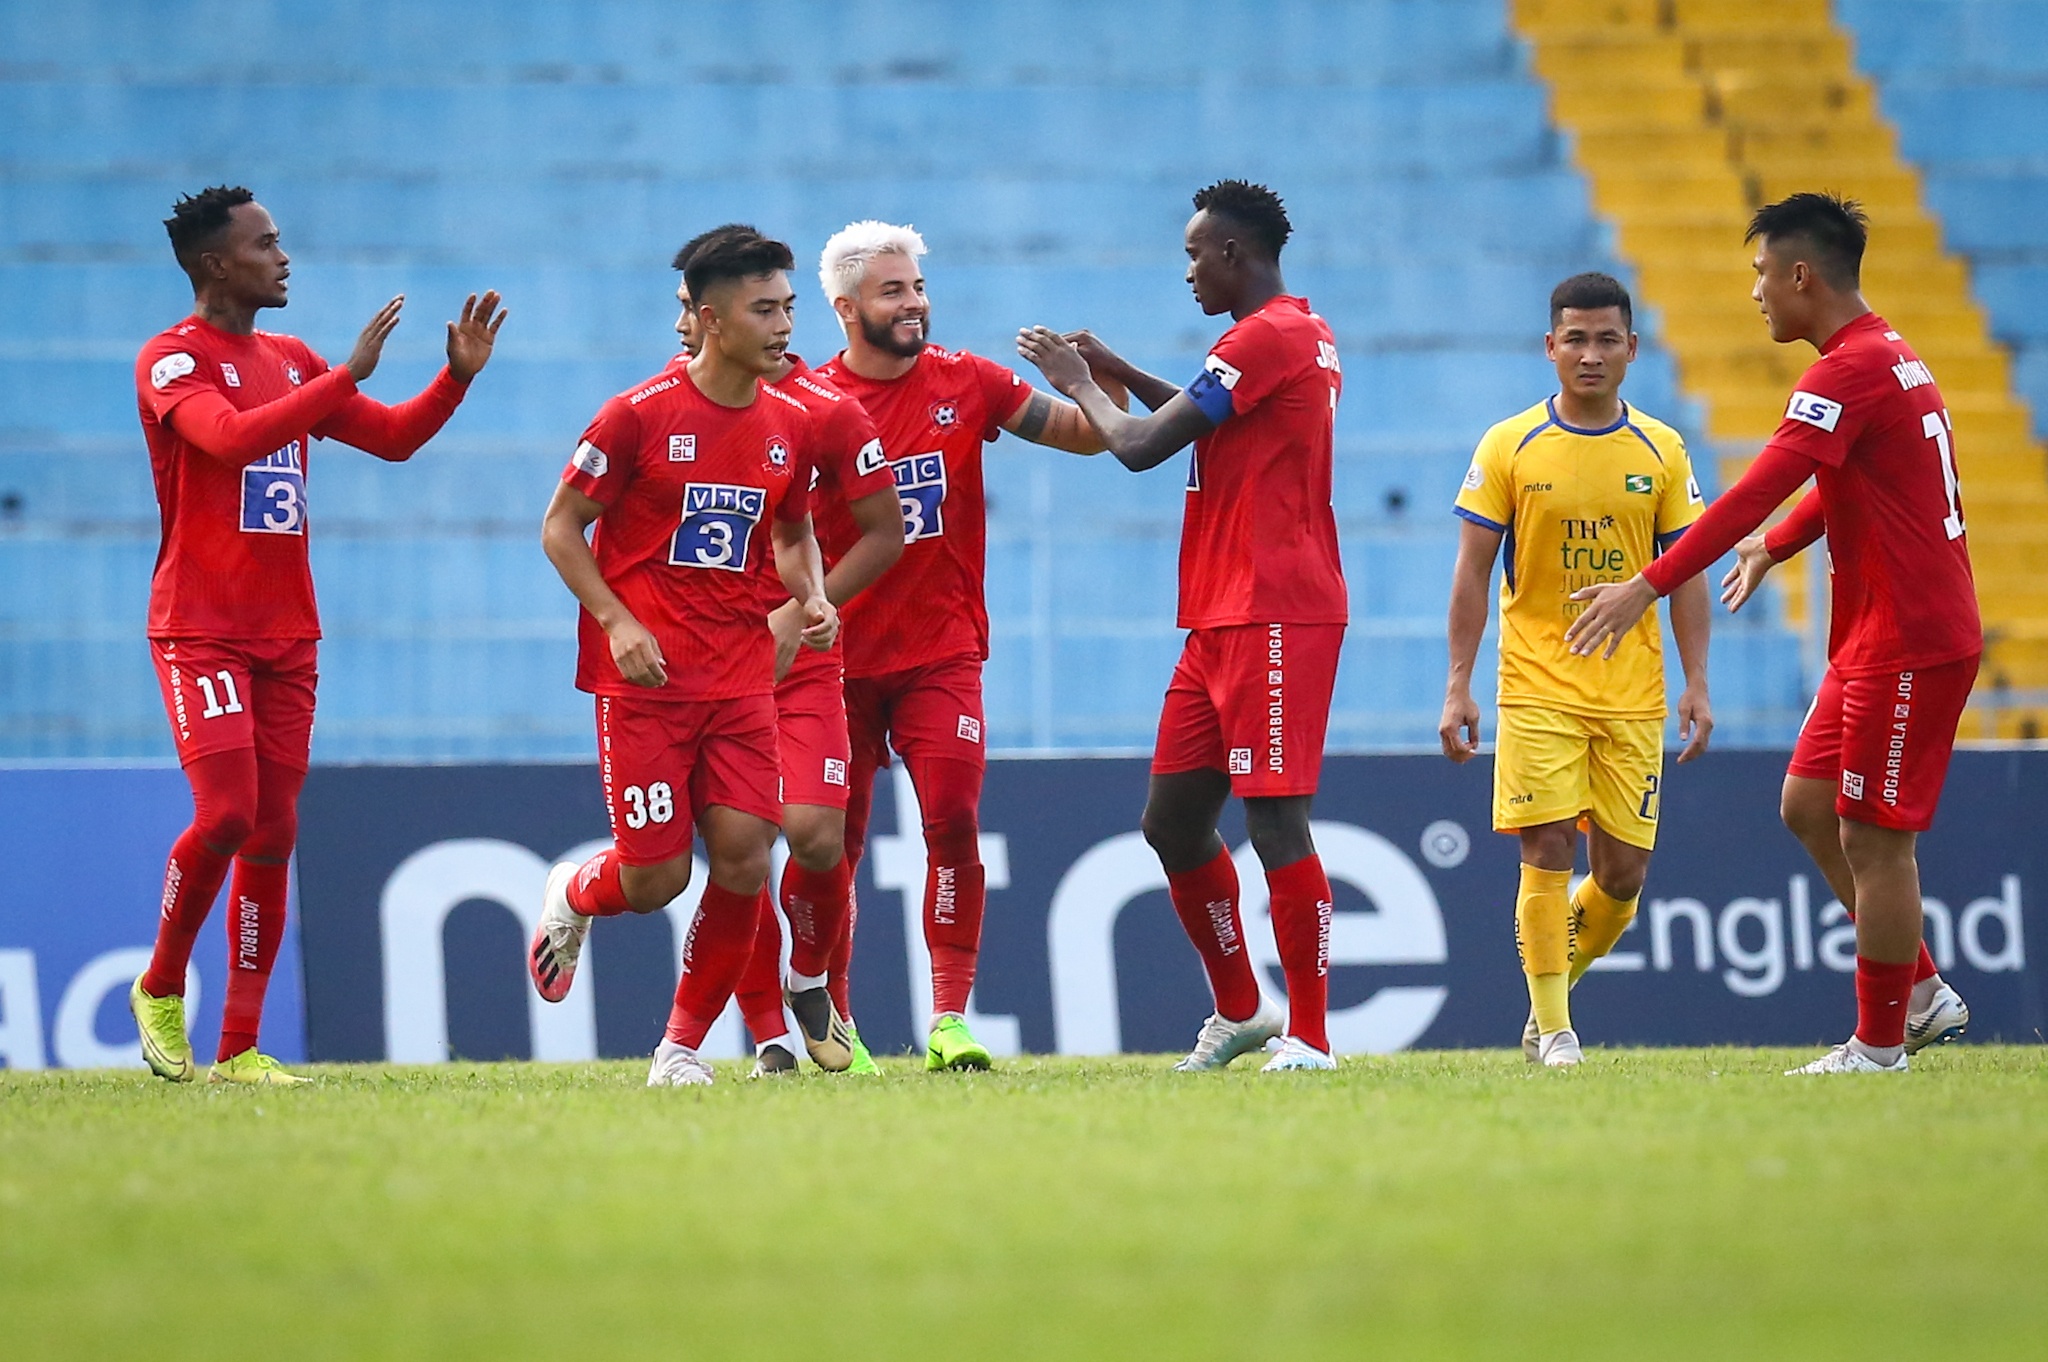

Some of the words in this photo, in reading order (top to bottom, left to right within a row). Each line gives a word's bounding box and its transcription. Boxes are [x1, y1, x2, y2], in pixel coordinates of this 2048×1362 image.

[629, 376, 681, 405] JOGARBOLA
[762, 383, 808, 413] JOGARBOLA
[794, 376, 841, 402] JOGARBOLA
[1190, 373, 1215, 400] C
[1793, 398, 1828, 421] LS
[894, 460, 937, 483] TC
[1524, 482, 1553, 494] mitre
[1921, 408, 1967, 541] 1
[263, 481, 299, 530] 3
[692, 490, 757, 514] VTC
[695, 521, 733, 565] 3
[1560, 519, 1599, 540] TH
[1560, 541, 1624, 571] true
[1269, 623, 1283, 667] JOGA
[170, 664, 190, 741] OGARBOLA
[197, 670, 243, 719] 11
[1269, 688, 1283, 774] JOGARBOLA
[1884, 723, 1907, 806] JOGARBOLA
[1898, 672, 1914, 700] JOG
[623, 781, 674, 829] 38
[1510, 793, 1533, 805] mitre
[380, 762, 1449, 1062] mtre
[935, 866, 955, 925] JOGARBOLA
[239, 896, 259, 970] JOGARBOLA
[1206, 898, 1240, 956] JOGARBOLA
[1316, 900, 1333, 977] JOGARBOLA
